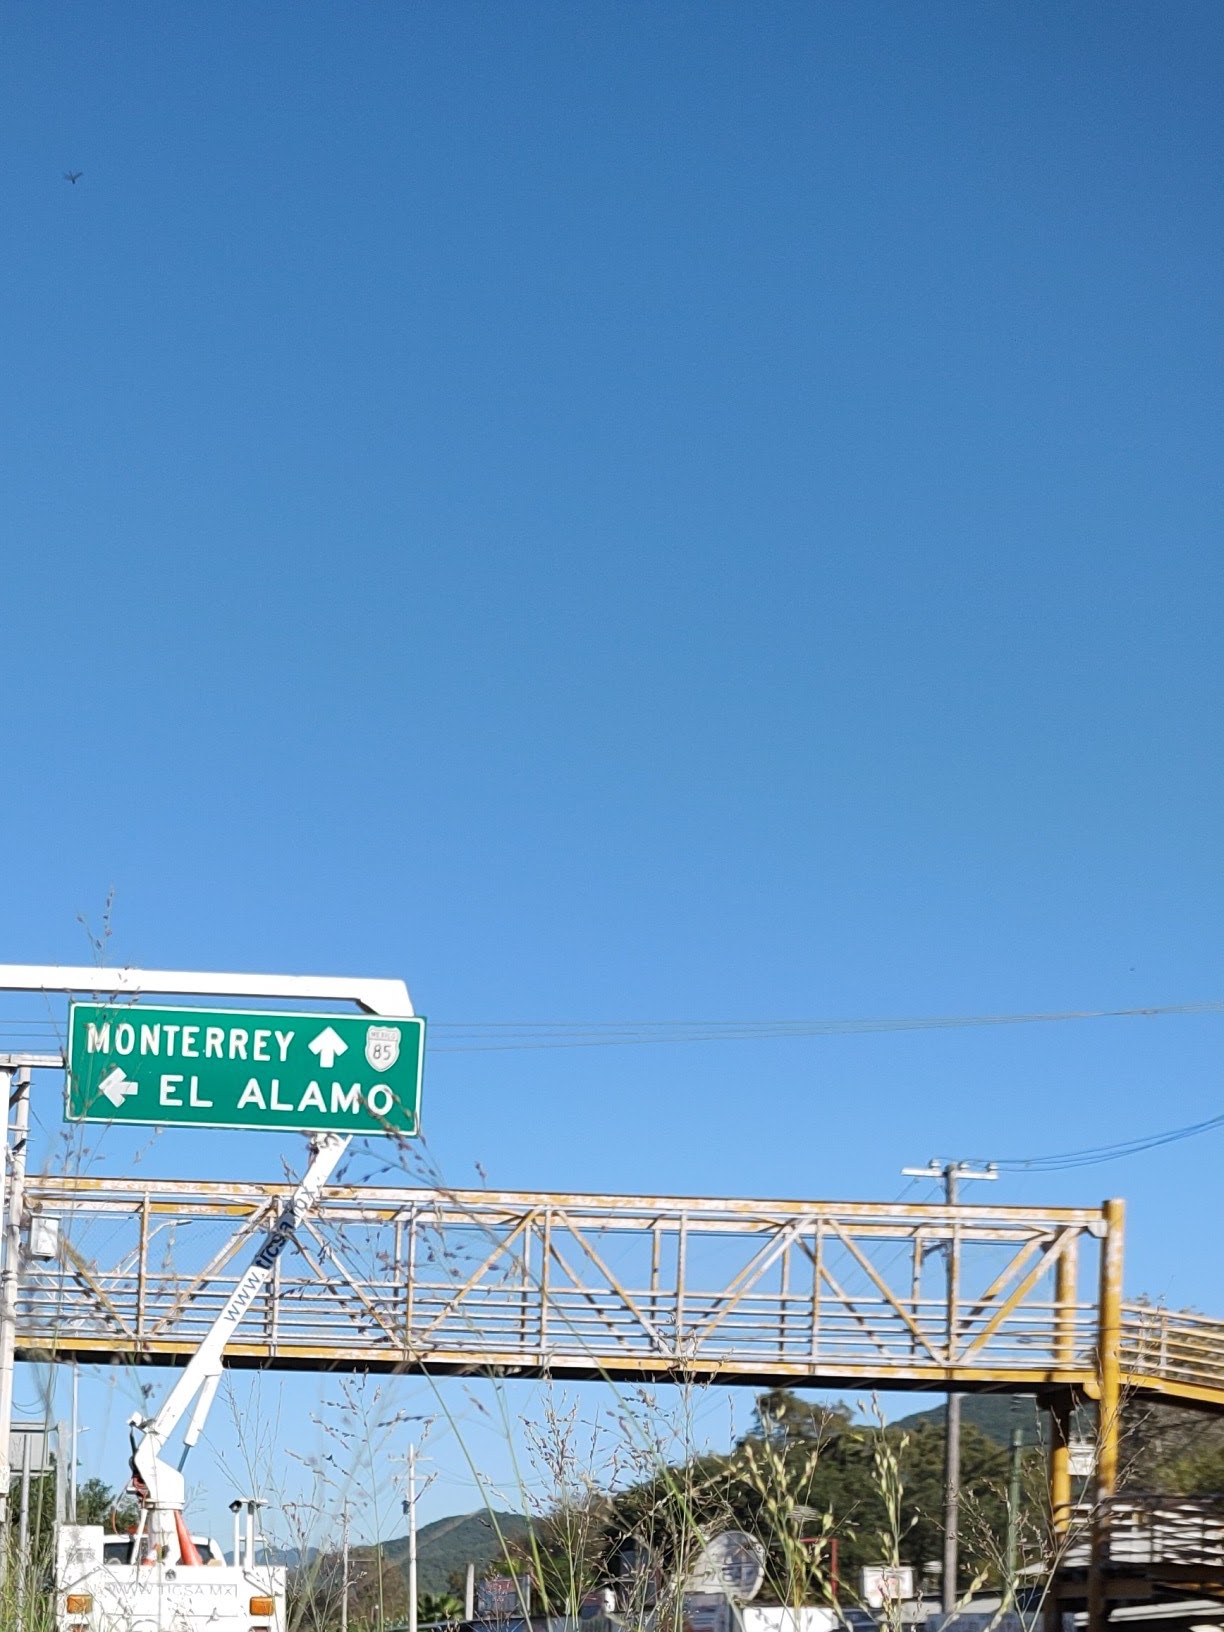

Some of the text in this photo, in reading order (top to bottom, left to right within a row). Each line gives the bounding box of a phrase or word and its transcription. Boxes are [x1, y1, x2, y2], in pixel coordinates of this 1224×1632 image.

[87, 1022, 295, 1062] MONTERREY
[373, 1044, 392, 1061] 85
[159, 1075, 395, 1116] EL ALAMO
